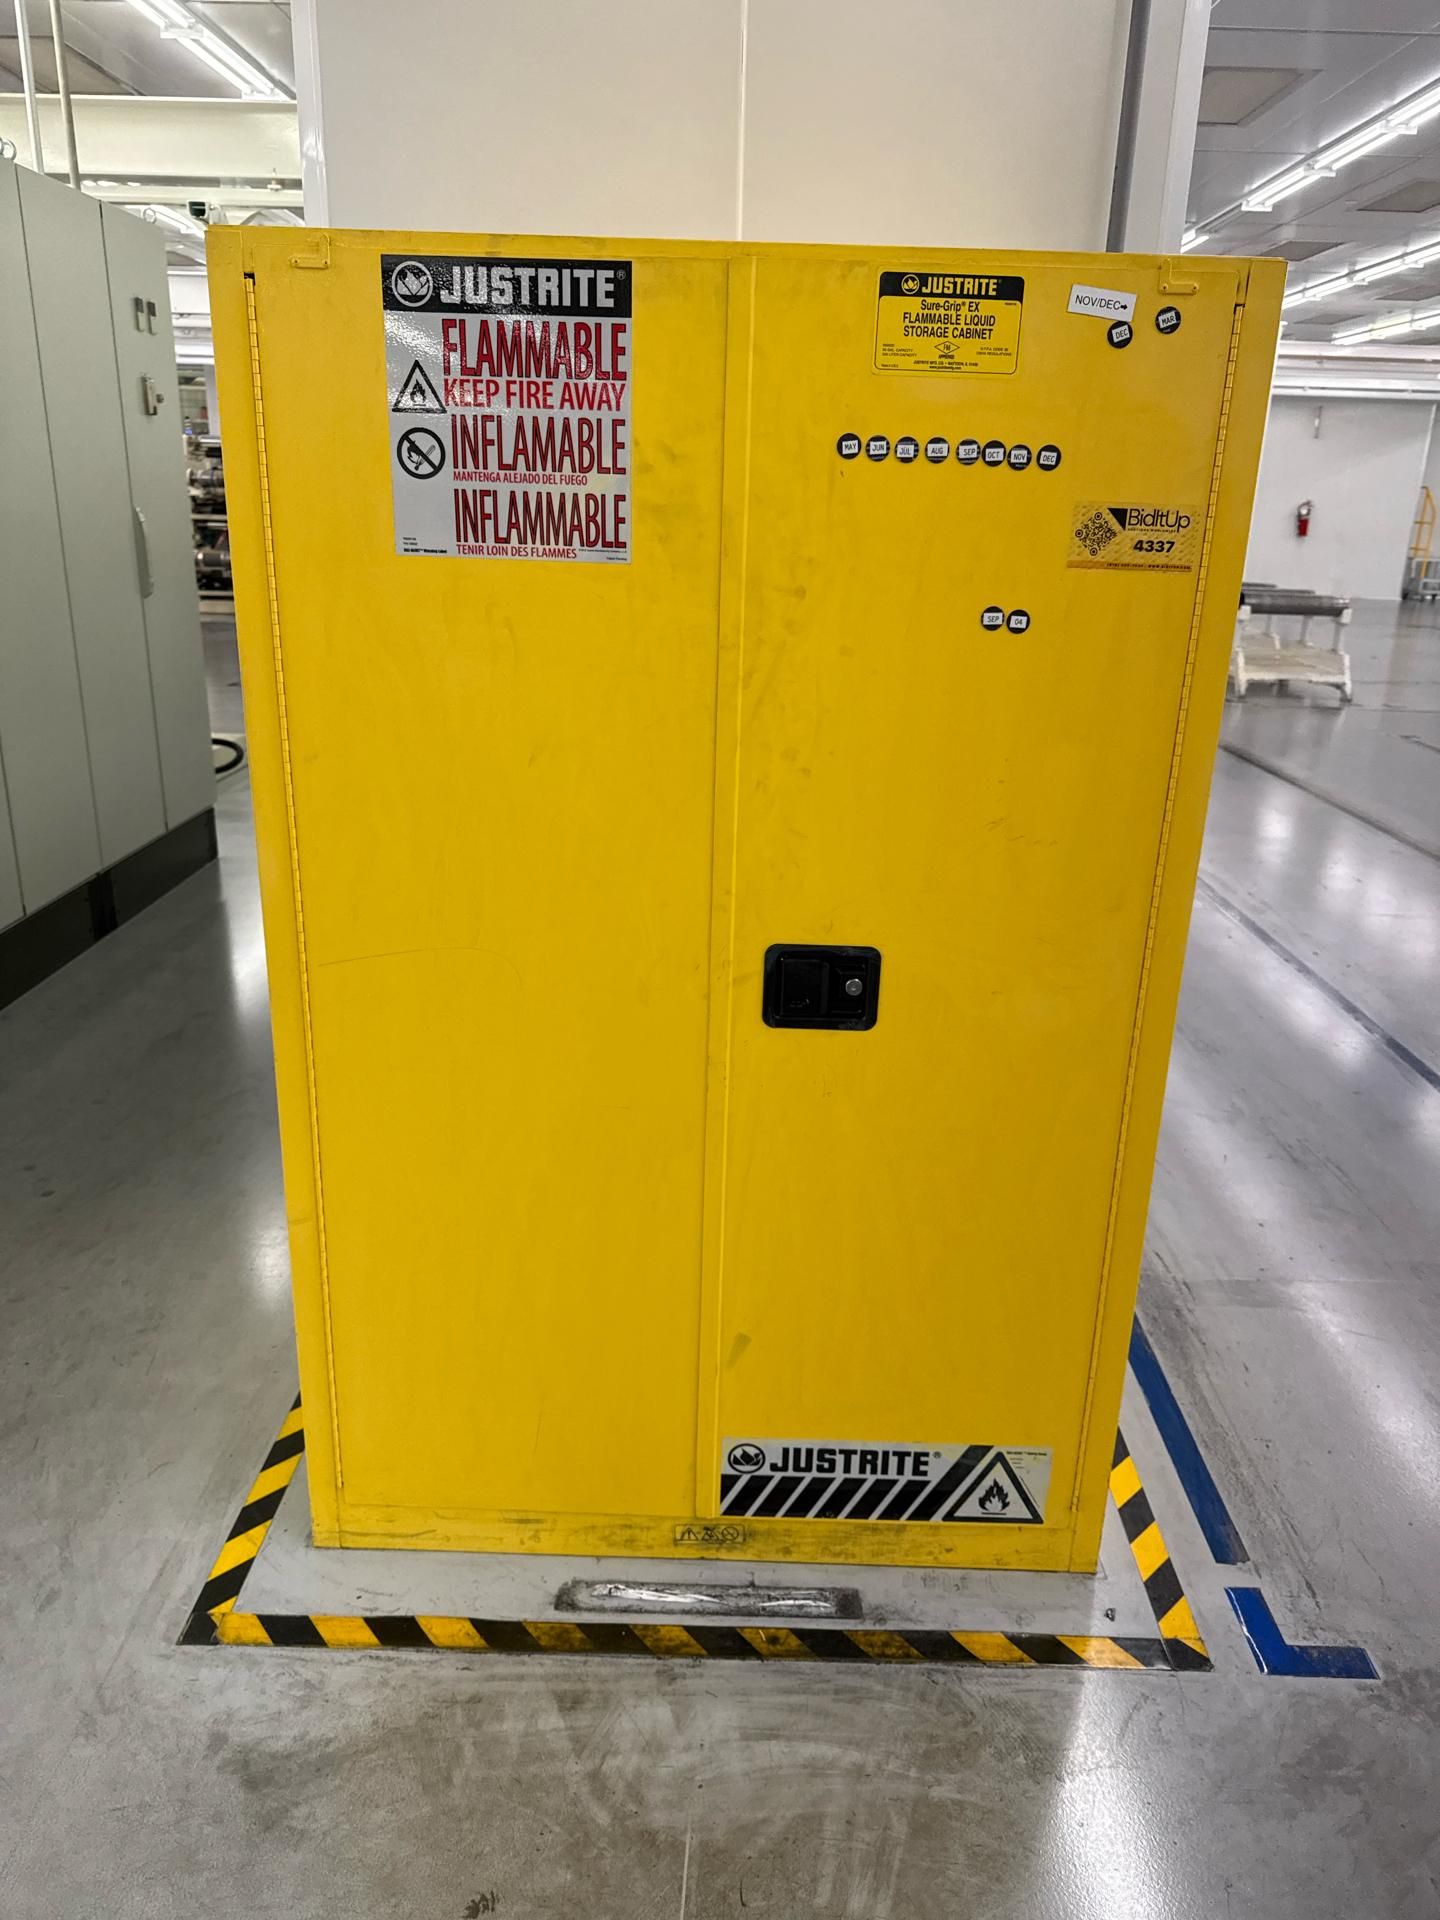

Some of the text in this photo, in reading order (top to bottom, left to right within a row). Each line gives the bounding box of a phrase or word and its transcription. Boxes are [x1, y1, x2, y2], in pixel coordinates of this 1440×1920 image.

[967, 301, 980, 313] EX
[1075, 294, 1121, 311] NOV/DEC
[903, 312, 996, 327] FLAMMABLE LIQUID
[1161, 315, 1175, 326] MAR
[903, 325, 994, 340] STORAGE CABINET
[1115, 328, 1129, 340] DEC
[441, 318, 627, 381] FLAMMABLE
[443, 378, 626, 412] KEEP FIRE AWAY
[451, 414, 627, 475] INFLAMABLE
[844, 443, 1056, 463] MAY JUN JUL AUG SEP OCT NOV DEC
[453, 471, 588, 486] MANTENGA ALEJADO DEL FUEGO
[454, 488, 627, 548] INFLAMMABLE
[456, 544, 485, 556] TENIR
[486, 545, 509, 557] LOIN
[511, 546, 529, 557] DES
[530, 547, 577, 559] FLAMMES
[1133, 539, 1176, 553] 4337
[987, 615, 1000, 623] SEP
